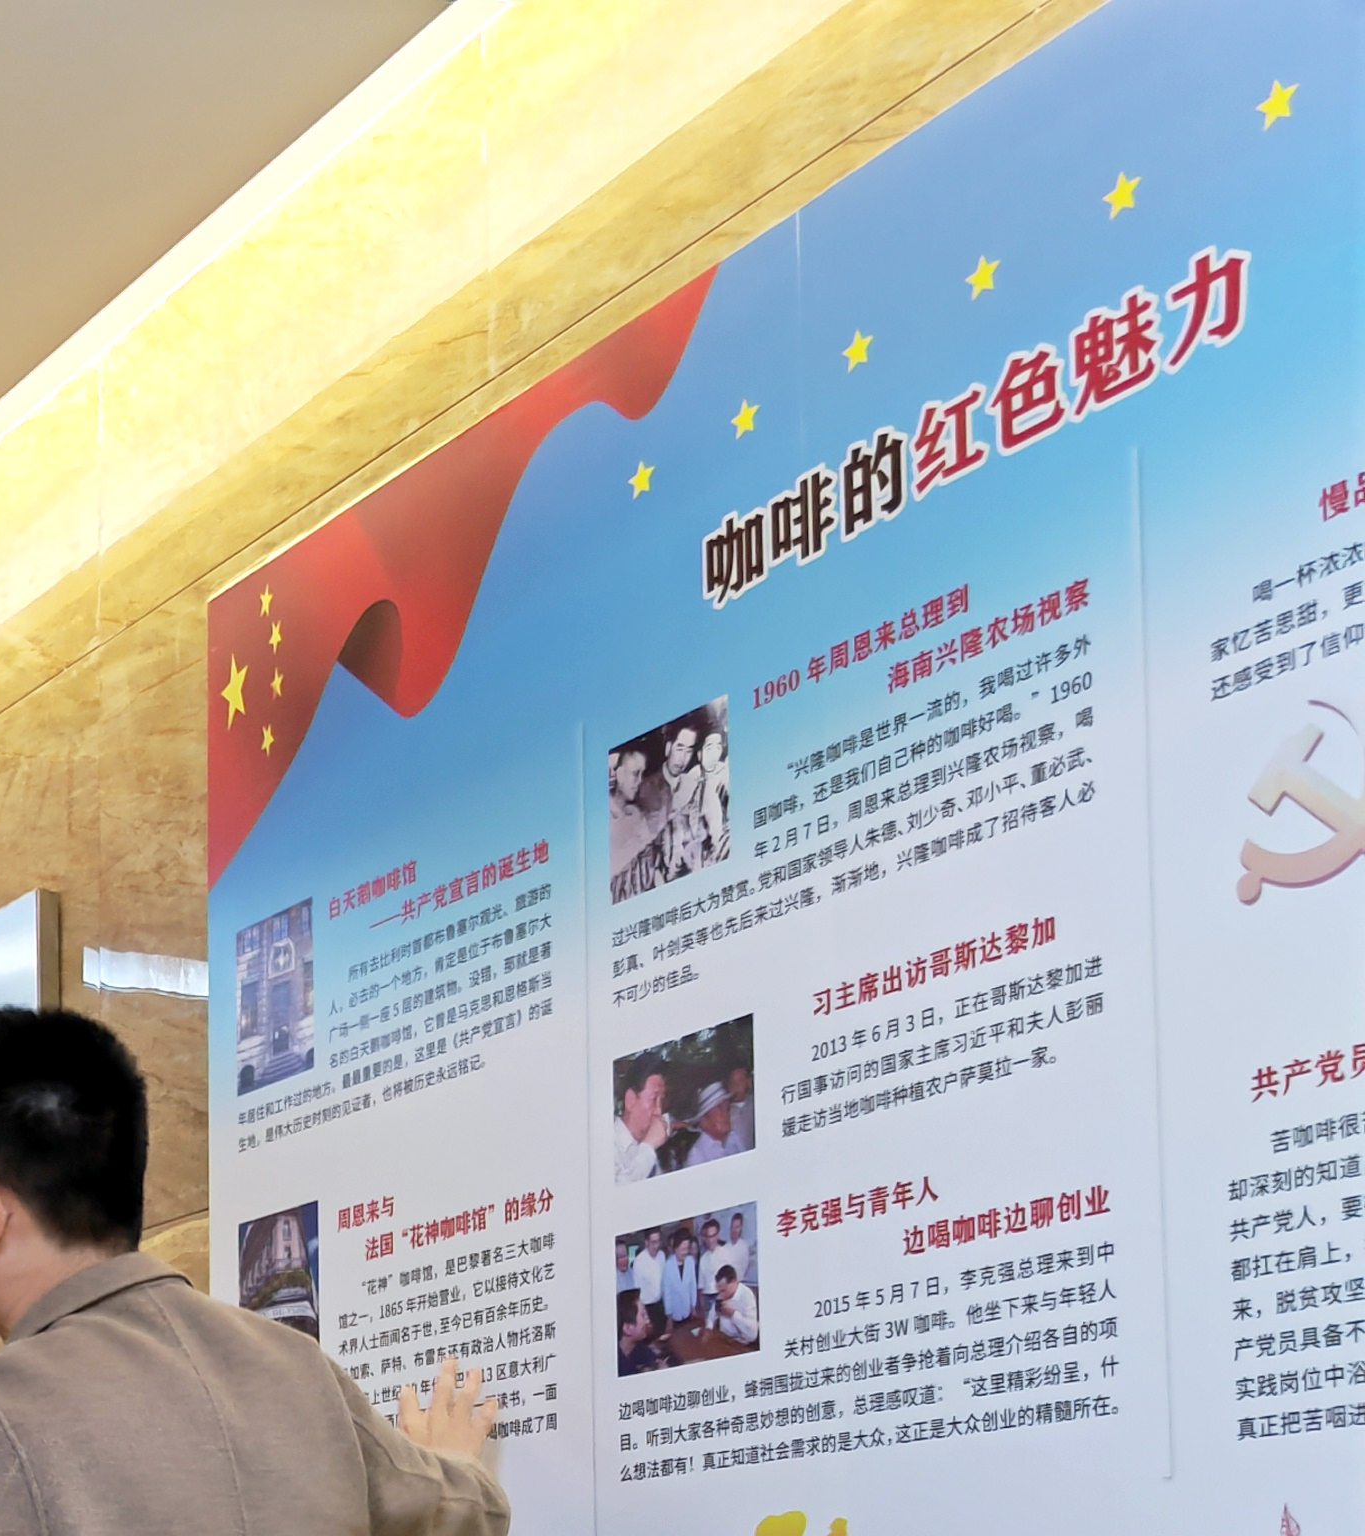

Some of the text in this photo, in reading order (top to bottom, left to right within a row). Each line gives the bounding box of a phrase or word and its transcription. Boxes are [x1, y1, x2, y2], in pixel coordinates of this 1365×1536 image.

[704, 247, 1251, 609] 咖啡的红色魅力
[887, 578, 1091, 694] 海南兴隆农场视察
[328, 860, 418, 921] 白天鹅咖啡馆
[813, 916, 1057, 1017] 习主席出访哥斯达黎加
[781, 992, 1104, 1106] 行国事访问的国家主席习近平和夫人彭丽
[1270, 1111, 1365, 1154] 苦咖啡很
[776, 1176, 939, 1238] 李克强与青年人
[1228, 1154, 1362, 1202] 却深刻的知道
[336, 1196, 395, 1233] 周恩来与
[903, 1185, 1111, 1257] 边喝咖啡边聊创业
[1233, 1320, 1365, 1362] 产党员具备不
